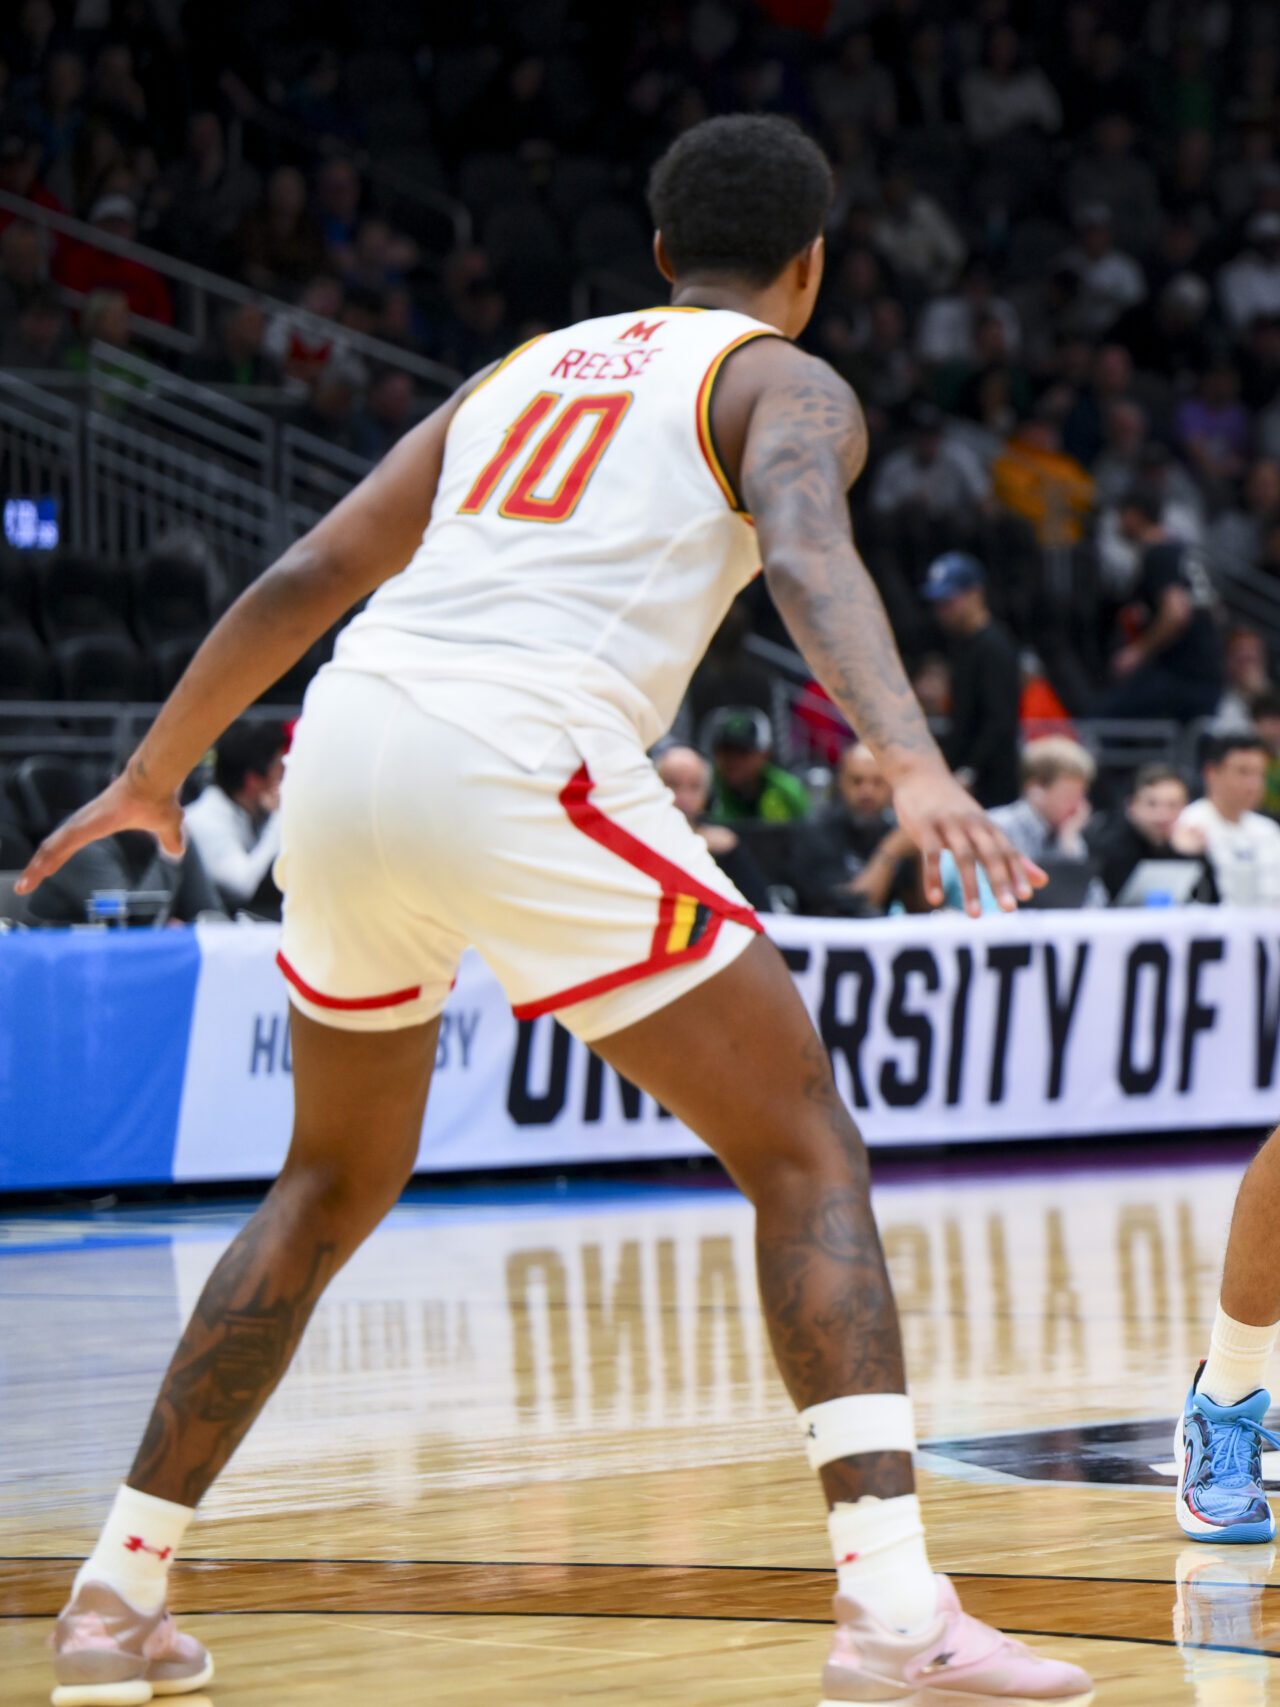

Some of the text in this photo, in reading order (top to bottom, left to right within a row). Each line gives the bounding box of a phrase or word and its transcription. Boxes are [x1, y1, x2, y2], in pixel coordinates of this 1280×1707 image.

[551, 348, 664, 379] REESE
[616, 320, 668, 342] M
[457, 390, 634, 523] 10
[1118, 938, 1224, 1095] OF
